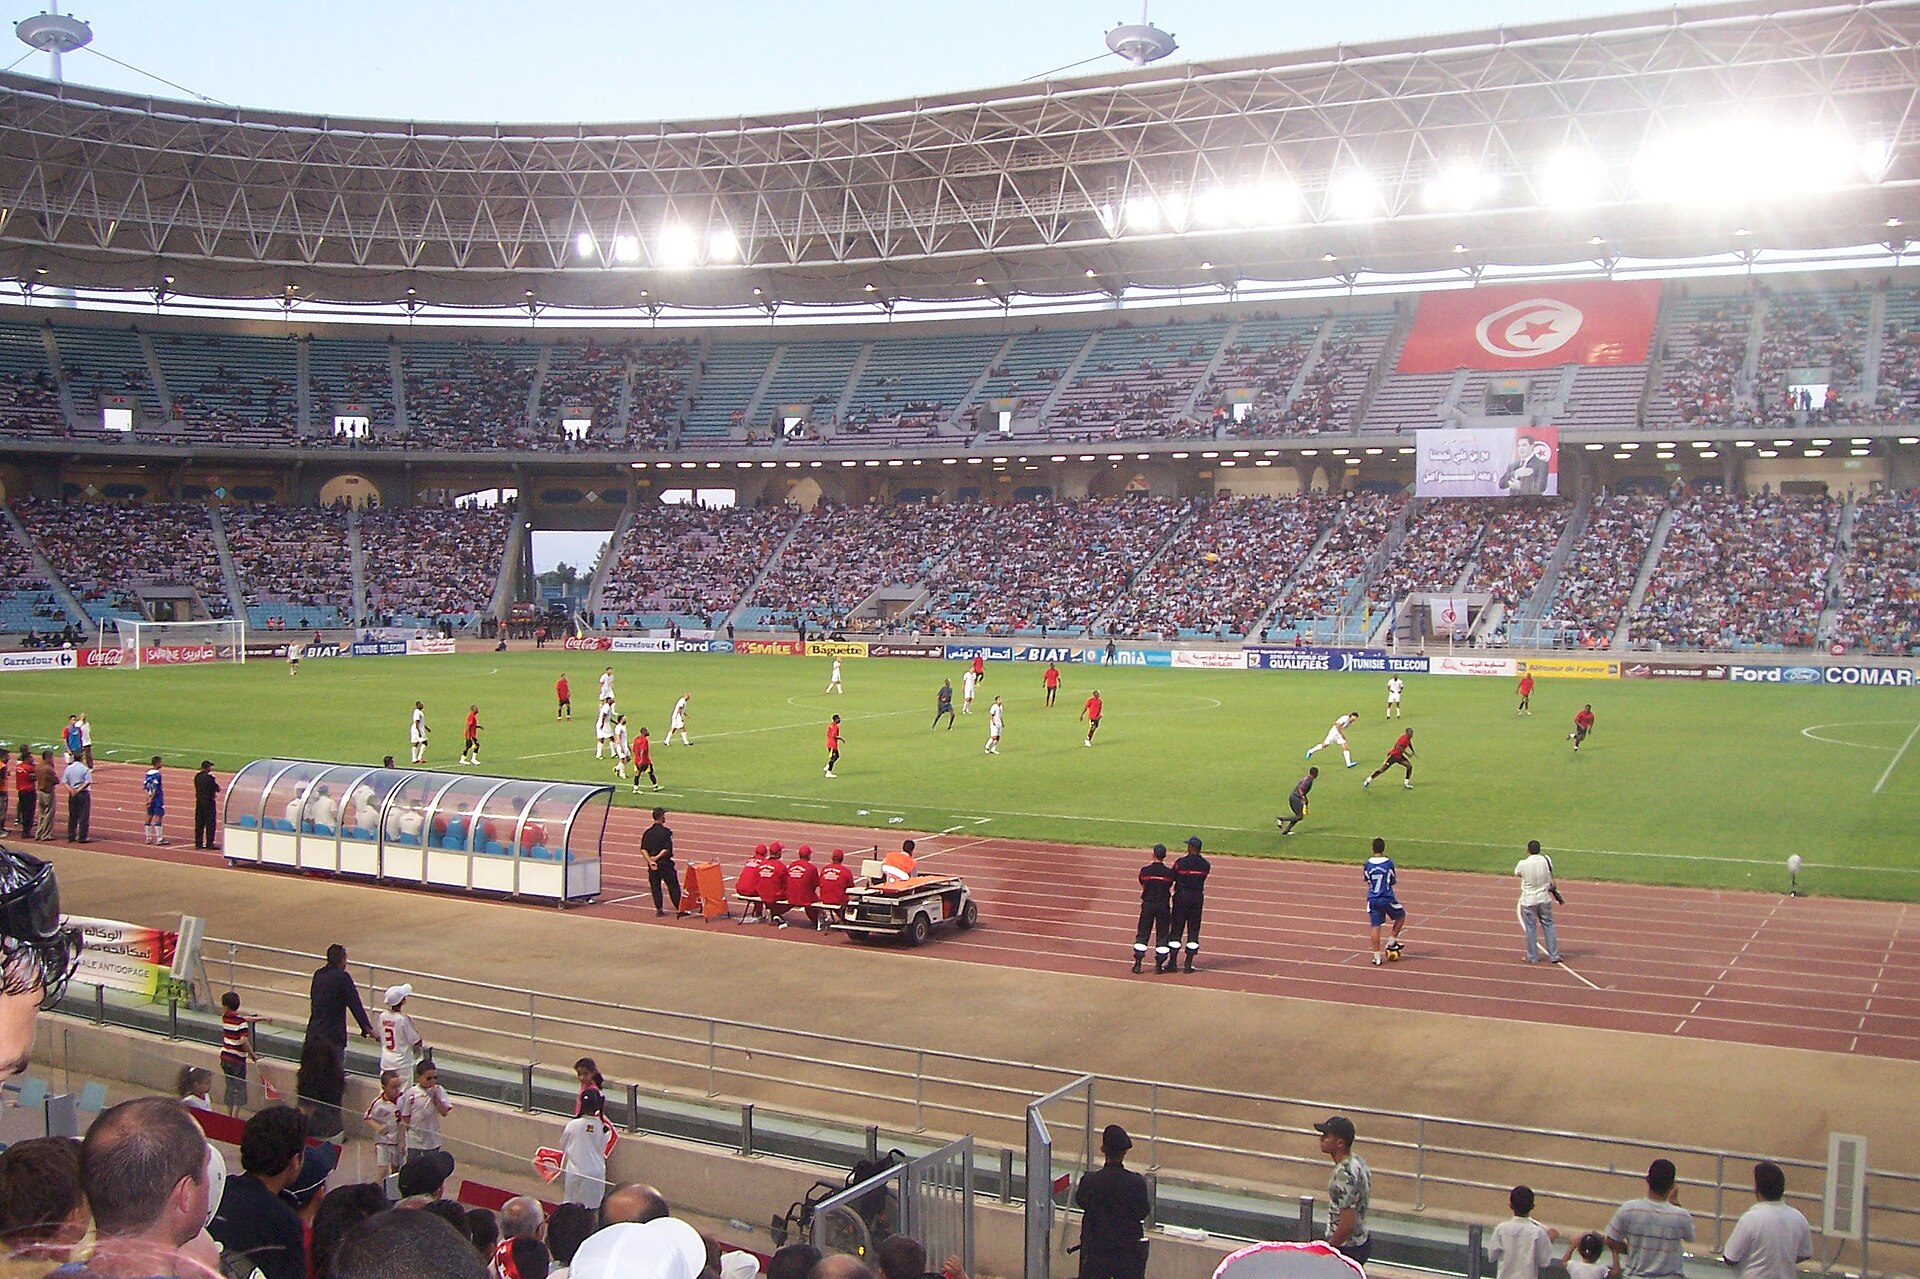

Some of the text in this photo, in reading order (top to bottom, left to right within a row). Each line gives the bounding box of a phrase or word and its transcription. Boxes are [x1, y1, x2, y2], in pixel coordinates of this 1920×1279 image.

[614, 640, 656, 649] Carrefour
[676, 640, 709, 652] Ford
[812, 645, 863, 657] Baguette
[307, 646, 340, 658] BIAT
[1028, 649, 1071, 662] BIAT
[4, 656, 53, 667] Carrefour
[1269, 659, 1329, 670] QUALIFIERS
[1352, 658, 1428, 671] TUNISIE TELECOM
[1731, 667, 1781, 681] Ford
[1826, 667, 1913, 686] COMAR
[1371, 873, 1384, 893] 7
[98, 961, 150, 979] ANTIDOPAGE
[384, 1027, 396, 1050] 3
